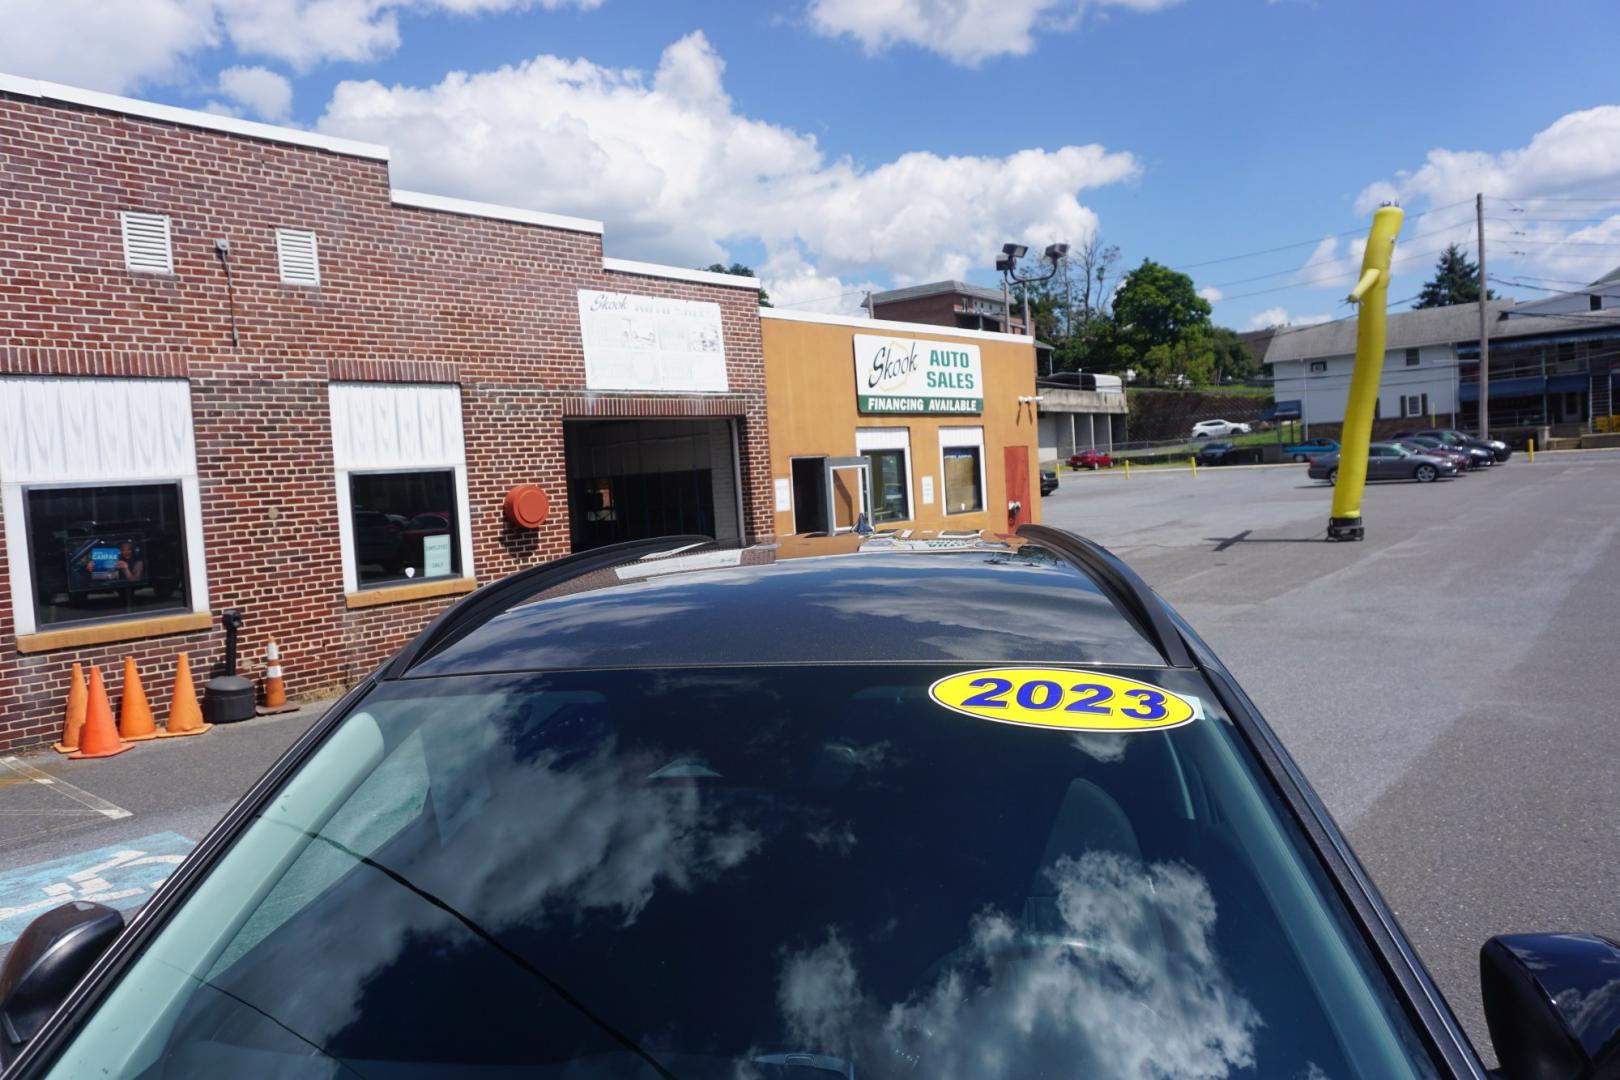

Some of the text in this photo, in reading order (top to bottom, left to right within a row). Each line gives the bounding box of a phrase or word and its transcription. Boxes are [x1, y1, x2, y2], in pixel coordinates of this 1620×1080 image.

[868, 341, 918, 388] Skook
[930, 350, 969, 368] AUTO
[926, 370, 974, 389] SALES
[867, 397, 977, 412] FINANCING AVAILABLE
[960, 677, 1170, 721] 2023
